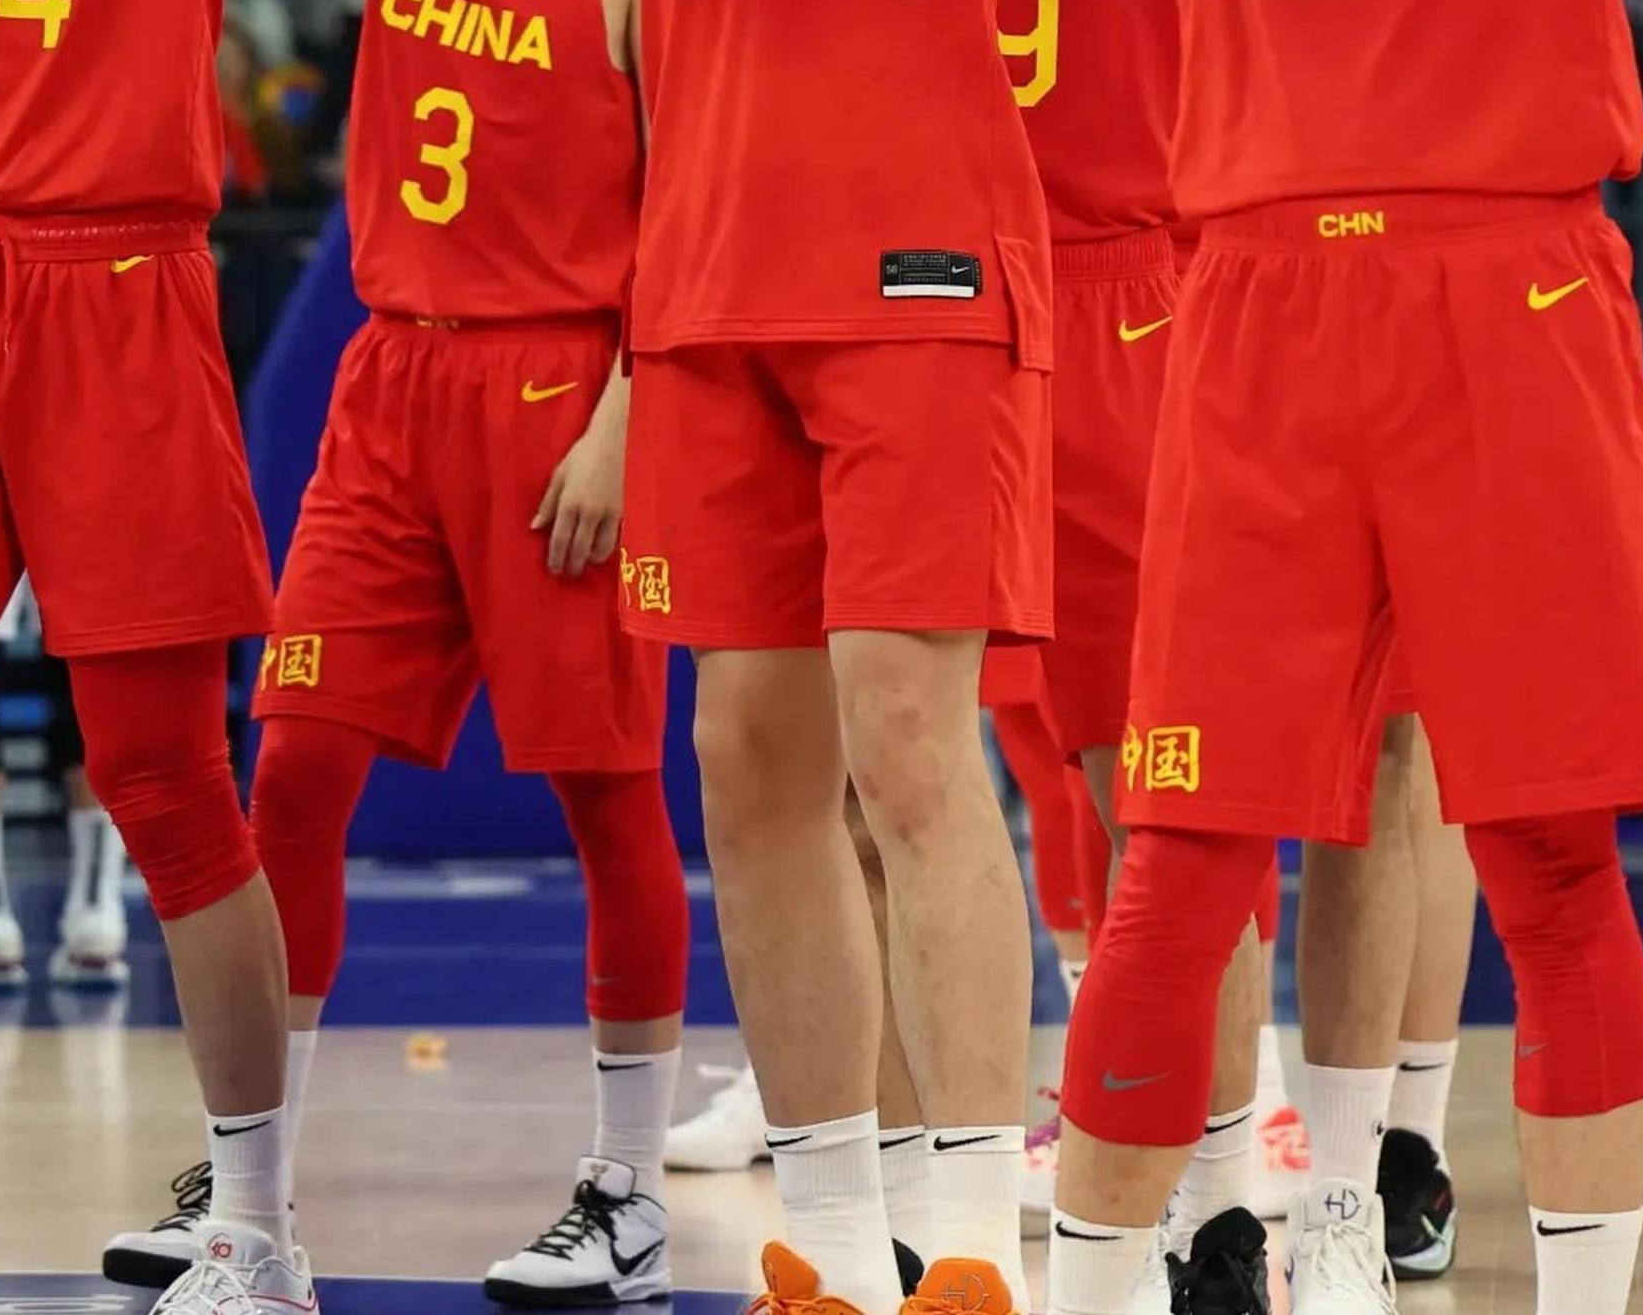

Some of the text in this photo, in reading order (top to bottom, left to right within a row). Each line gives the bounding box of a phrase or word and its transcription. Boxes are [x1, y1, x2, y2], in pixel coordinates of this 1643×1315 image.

[400, 87, 474, 224] 3
[1318, 211, 1385, 237] CHN
[1121, 723, 1201, 793] 中国
